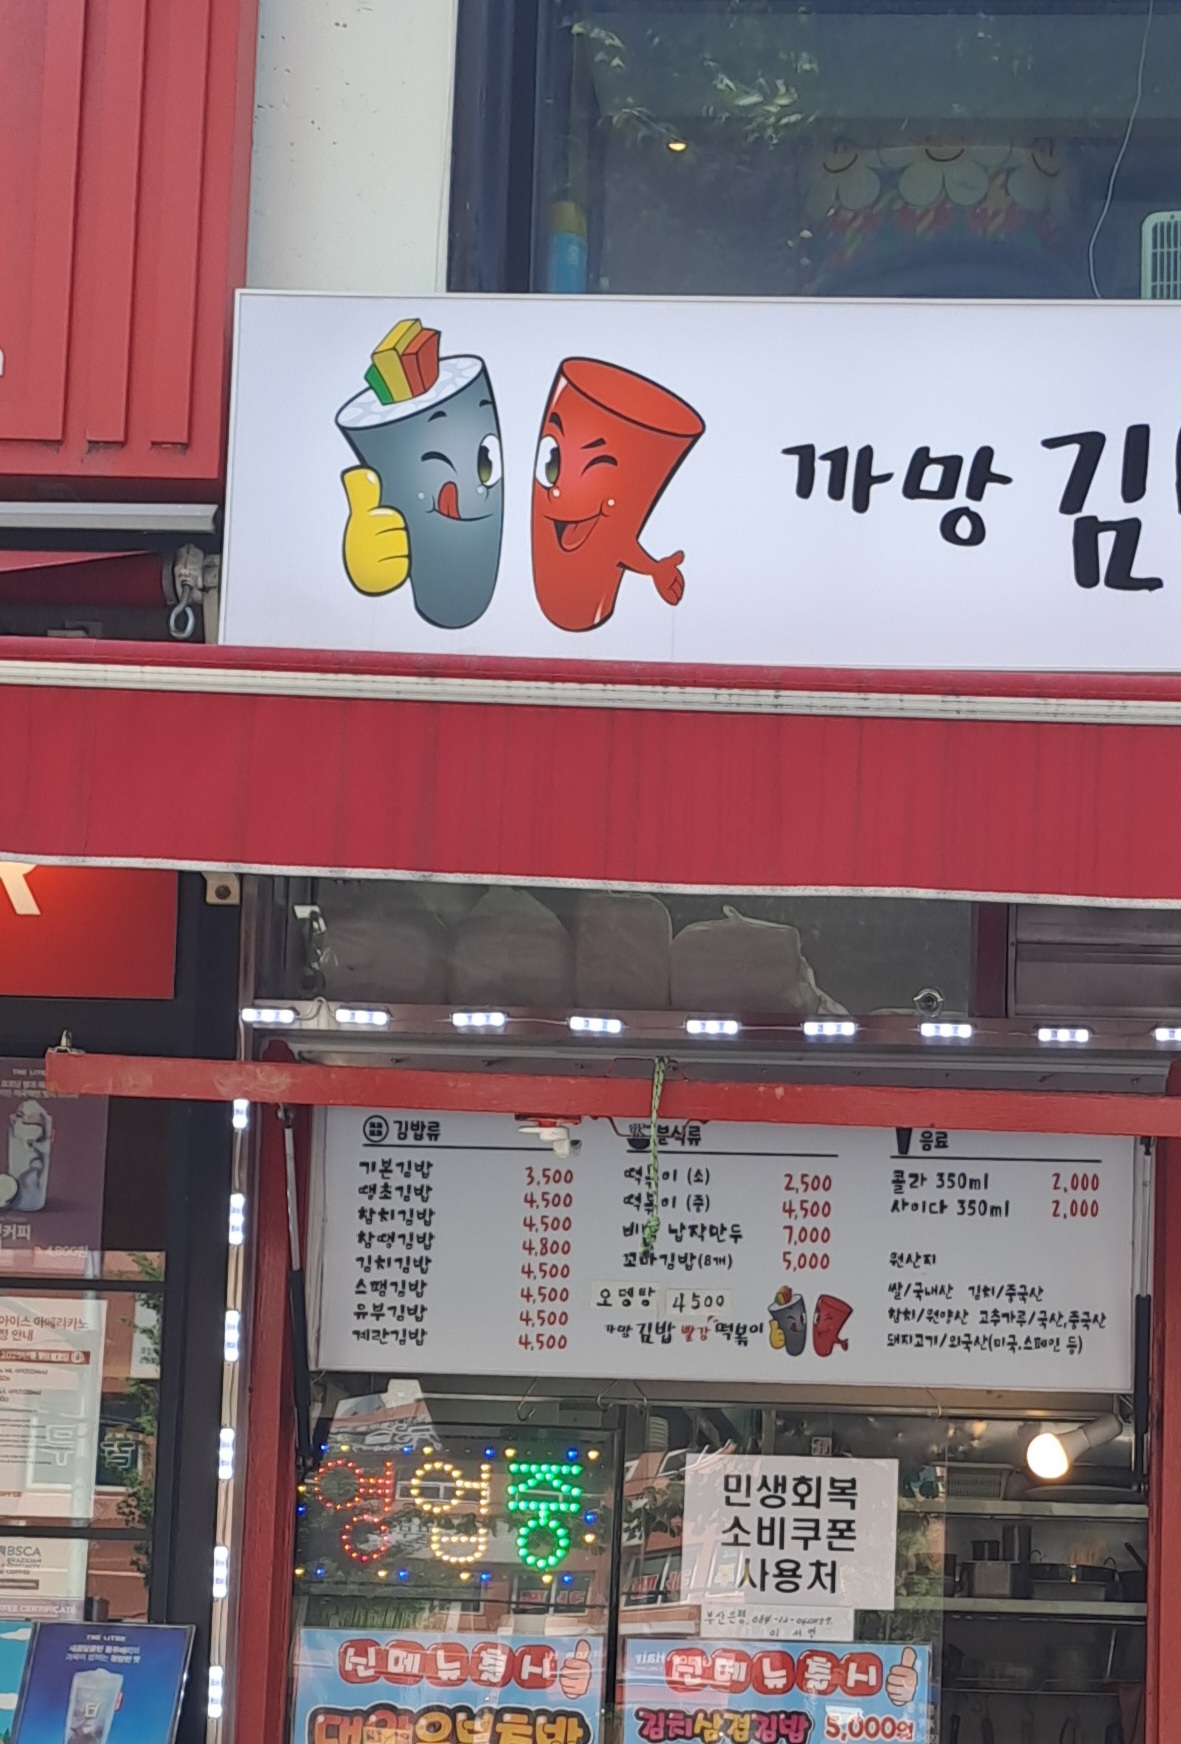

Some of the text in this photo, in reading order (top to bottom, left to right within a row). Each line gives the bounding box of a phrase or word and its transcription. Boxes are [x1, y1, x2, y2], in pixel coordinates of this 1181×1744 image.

[782, 439, 1011, 548] 까망
[393, 1120, 441, 1142] 김밥류
[919, 1129, 949, 1152] 음료
[359, 1158, 574, 1188] 기본김밥 3,500
[686, 1167, 710, 1186] (소)
[783, 1173, 832, 1194] 2,500
[891, 1170, 1101, 1195] 콜라 350ml 2,000
[358, 1182, 573, 1213] 땡초김밥 4,500
[686, 1194, 710, 1213] (중)
[782, 1200, 832, 1221] 4,500
[890, 1199, 1100, 1221] 사이다 350ml 2,000
[357, 1206, 572, 1237] 참치김밥 4,500
[623, 1222, 831, 1246] 비 납작만두 7,000
[356, 1230, 571, 1260] 참땡김밥 4,800
[355, 1255, 571, 1284] 김치김밥 4,500
[782, 1251, 830, 1273] 5,000
[889, 1252, 936, 1269] 원산지
[354, 1278, 570, 1308] 스팸김밥 4,500
[672, 1293, 725, 1313] 4500
[353, 1303, 569, 1331] 유부김밥 4,500
[352, 1328, 568, 1355] 계란김밥 4,500
[636, 1322, 677, 1344] 김밥
[714, 1322, 764, 1347] 떡볶이
[723, 1474, 858, 1510] 민생회복
[312, 1458, 584, 1571] 영업중
[721, 1516, 857, 1552] 소비쿠폰
[7, 1546, 41, 1557] BSCA
[738, 1559, 837, 1593] 사용처
[639, 1710, 914, 1744] 김치삼겹김밥 5,000원
